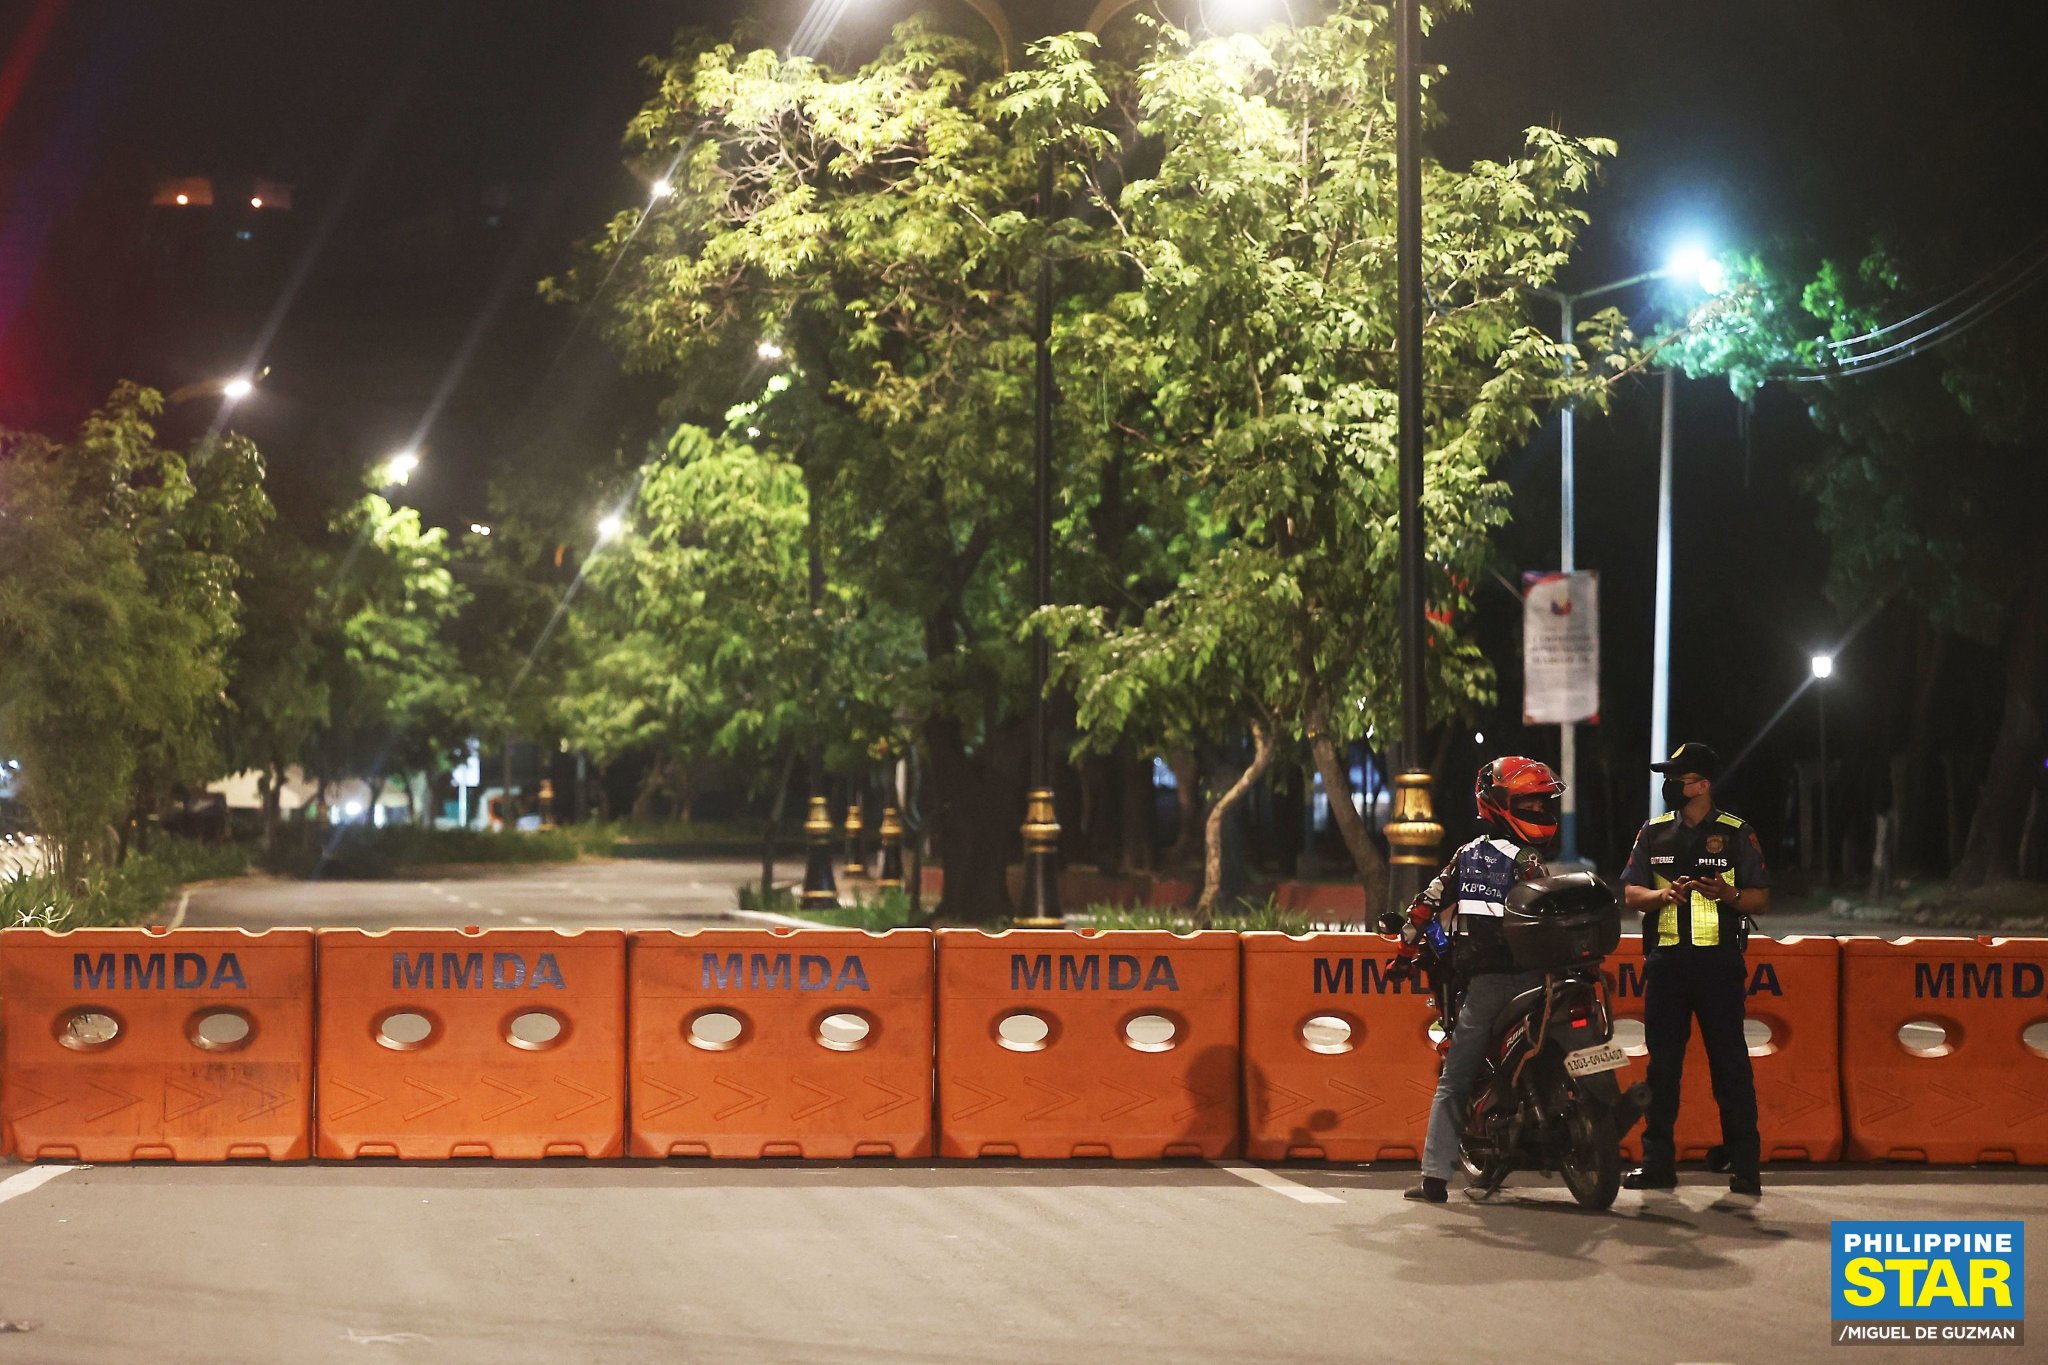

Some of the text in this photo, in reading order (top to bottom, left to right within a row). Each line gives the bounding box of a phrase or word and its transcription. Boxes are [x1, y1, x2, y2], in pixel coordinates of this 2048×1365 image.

[1698, 858, 1728, 867] PULIS
[73, 953, 247, 989] MMDA
[392, 952, 567, 989] MMDA
[701, 953, 870, 991] MMDA
[1010, 954, 1180, 992] MMDA
[1619, 963, 1783, 997] MA
[1915, 962, 2048, 998] MMD
